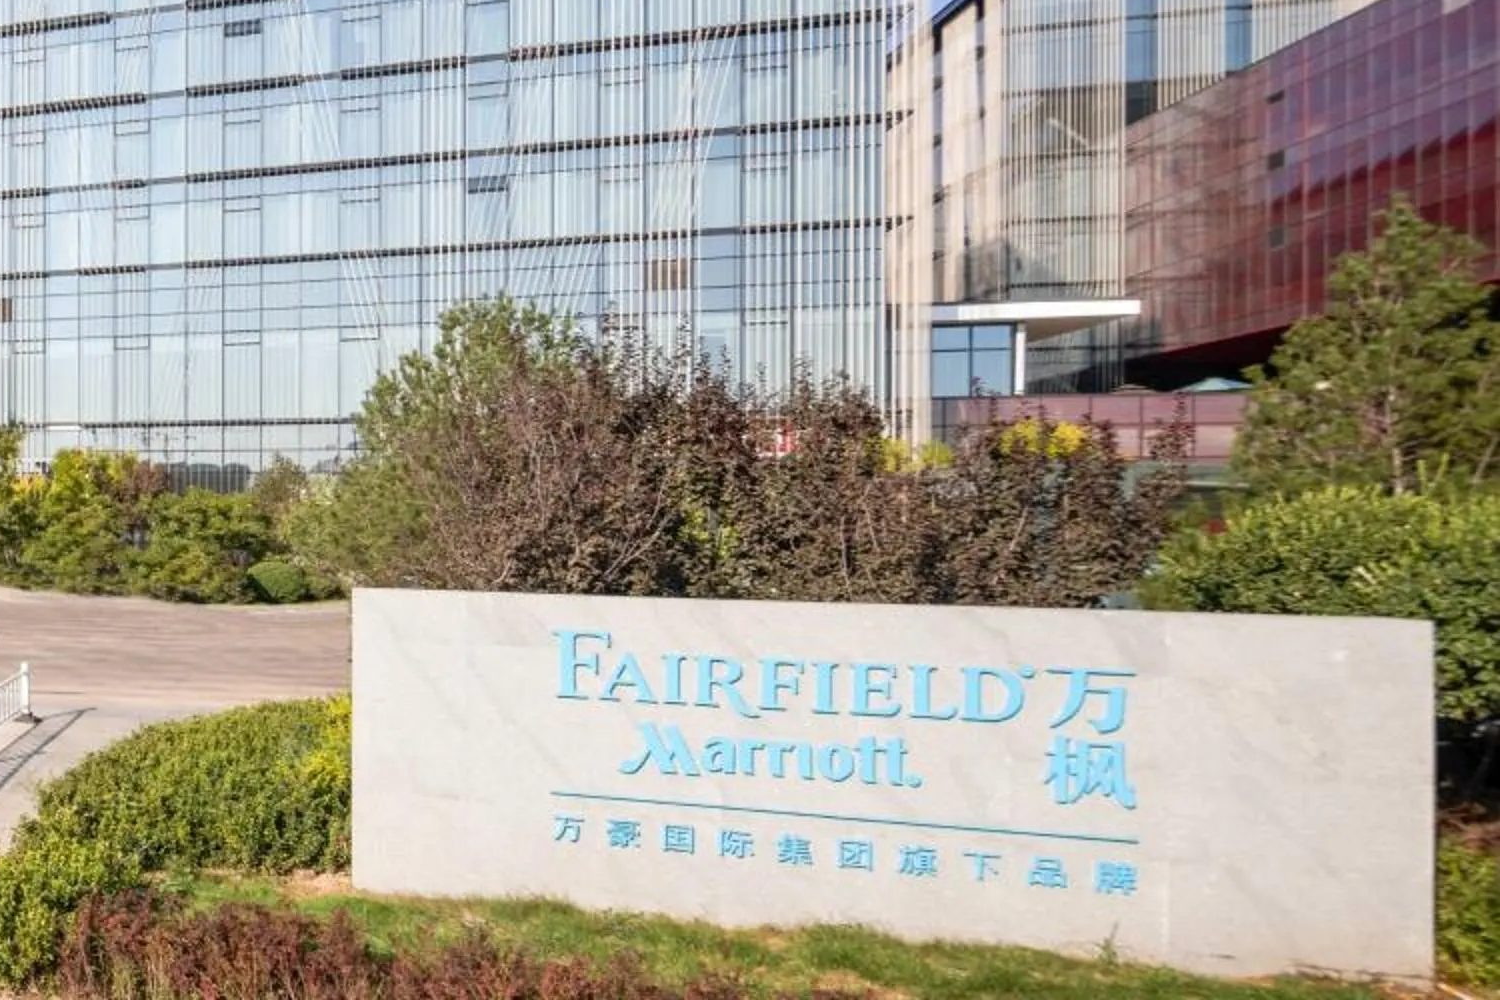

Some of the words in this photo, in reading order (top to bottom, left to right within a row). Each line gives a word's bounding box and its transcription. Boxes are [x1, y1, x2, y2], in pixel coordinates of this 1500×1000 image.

[552, 629, 1028, 724] FAIRFIELD
[553, 815, 1139, 898] 万豪国际集团旗下品牌
